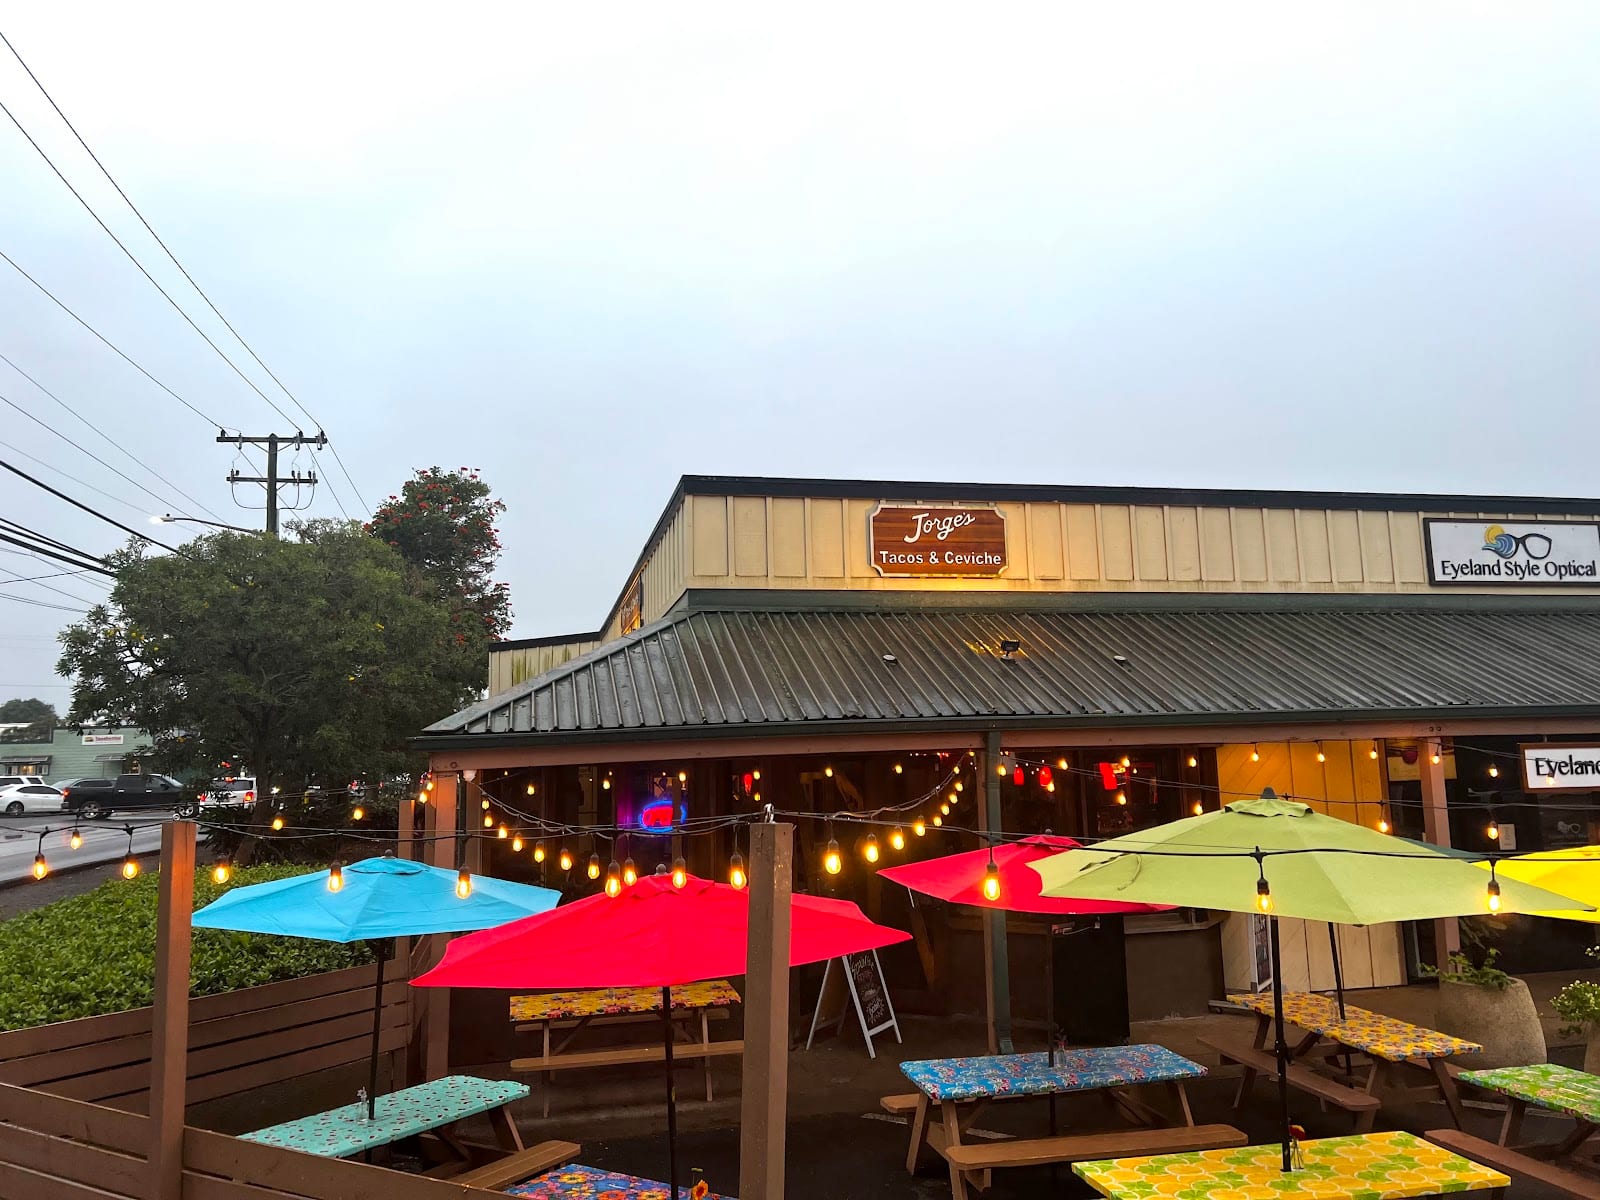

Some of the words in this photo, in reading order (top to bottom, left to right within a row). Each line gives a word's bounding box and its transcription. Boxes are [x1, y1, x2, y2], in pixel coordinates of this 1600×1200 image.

[879, 550, 924, 564] Tacos
[928, 551, 940, 564] &
[944, 551, 1002, 565] Ceviche
[1441, 559, 1501, 580] Eyeland
[1504, 559, 1541, 580] Style
[1544, 559, 1597, 580] Optical
